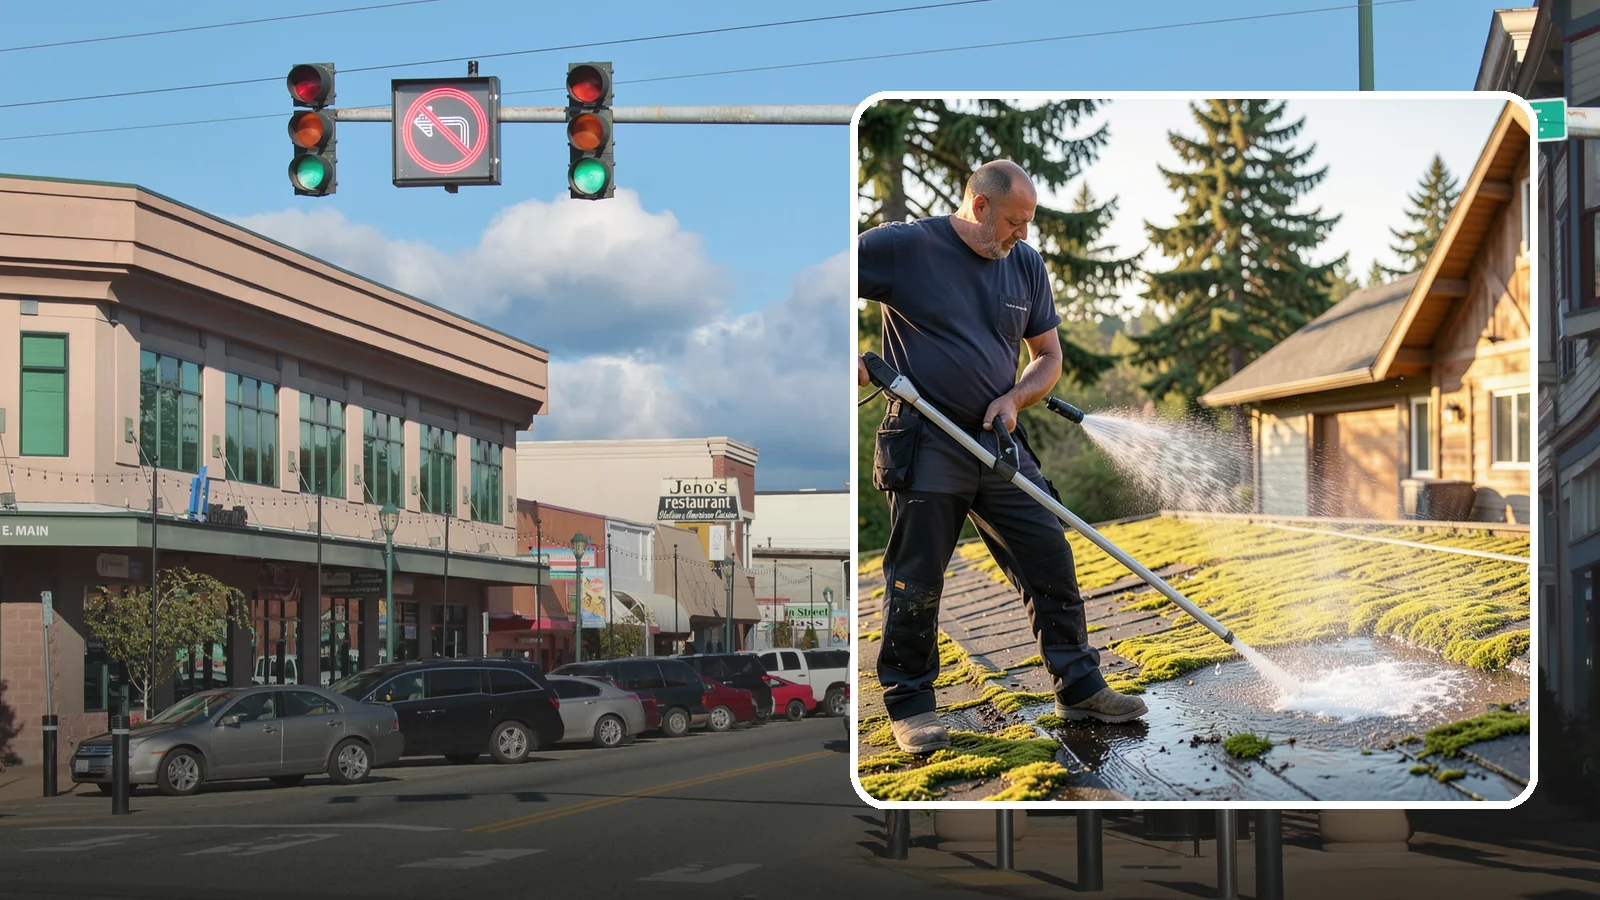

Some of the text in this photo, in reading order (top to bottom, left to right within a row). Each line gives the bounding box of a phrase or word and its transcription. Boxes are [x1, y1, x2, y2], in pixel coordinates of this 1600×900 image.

[670, 480, 728, 494] Jeno's
[665, 496, 731, 509] restaurant
[658, 510, 681, 519] Italian
[686, 509, 714, 519] American
[714, 509, 738, 519] Cuisine
[2, 525, 49, 536] E. MAIN
[797, 607, 829, 617] Street
[791, 619, 823, 627] lass
